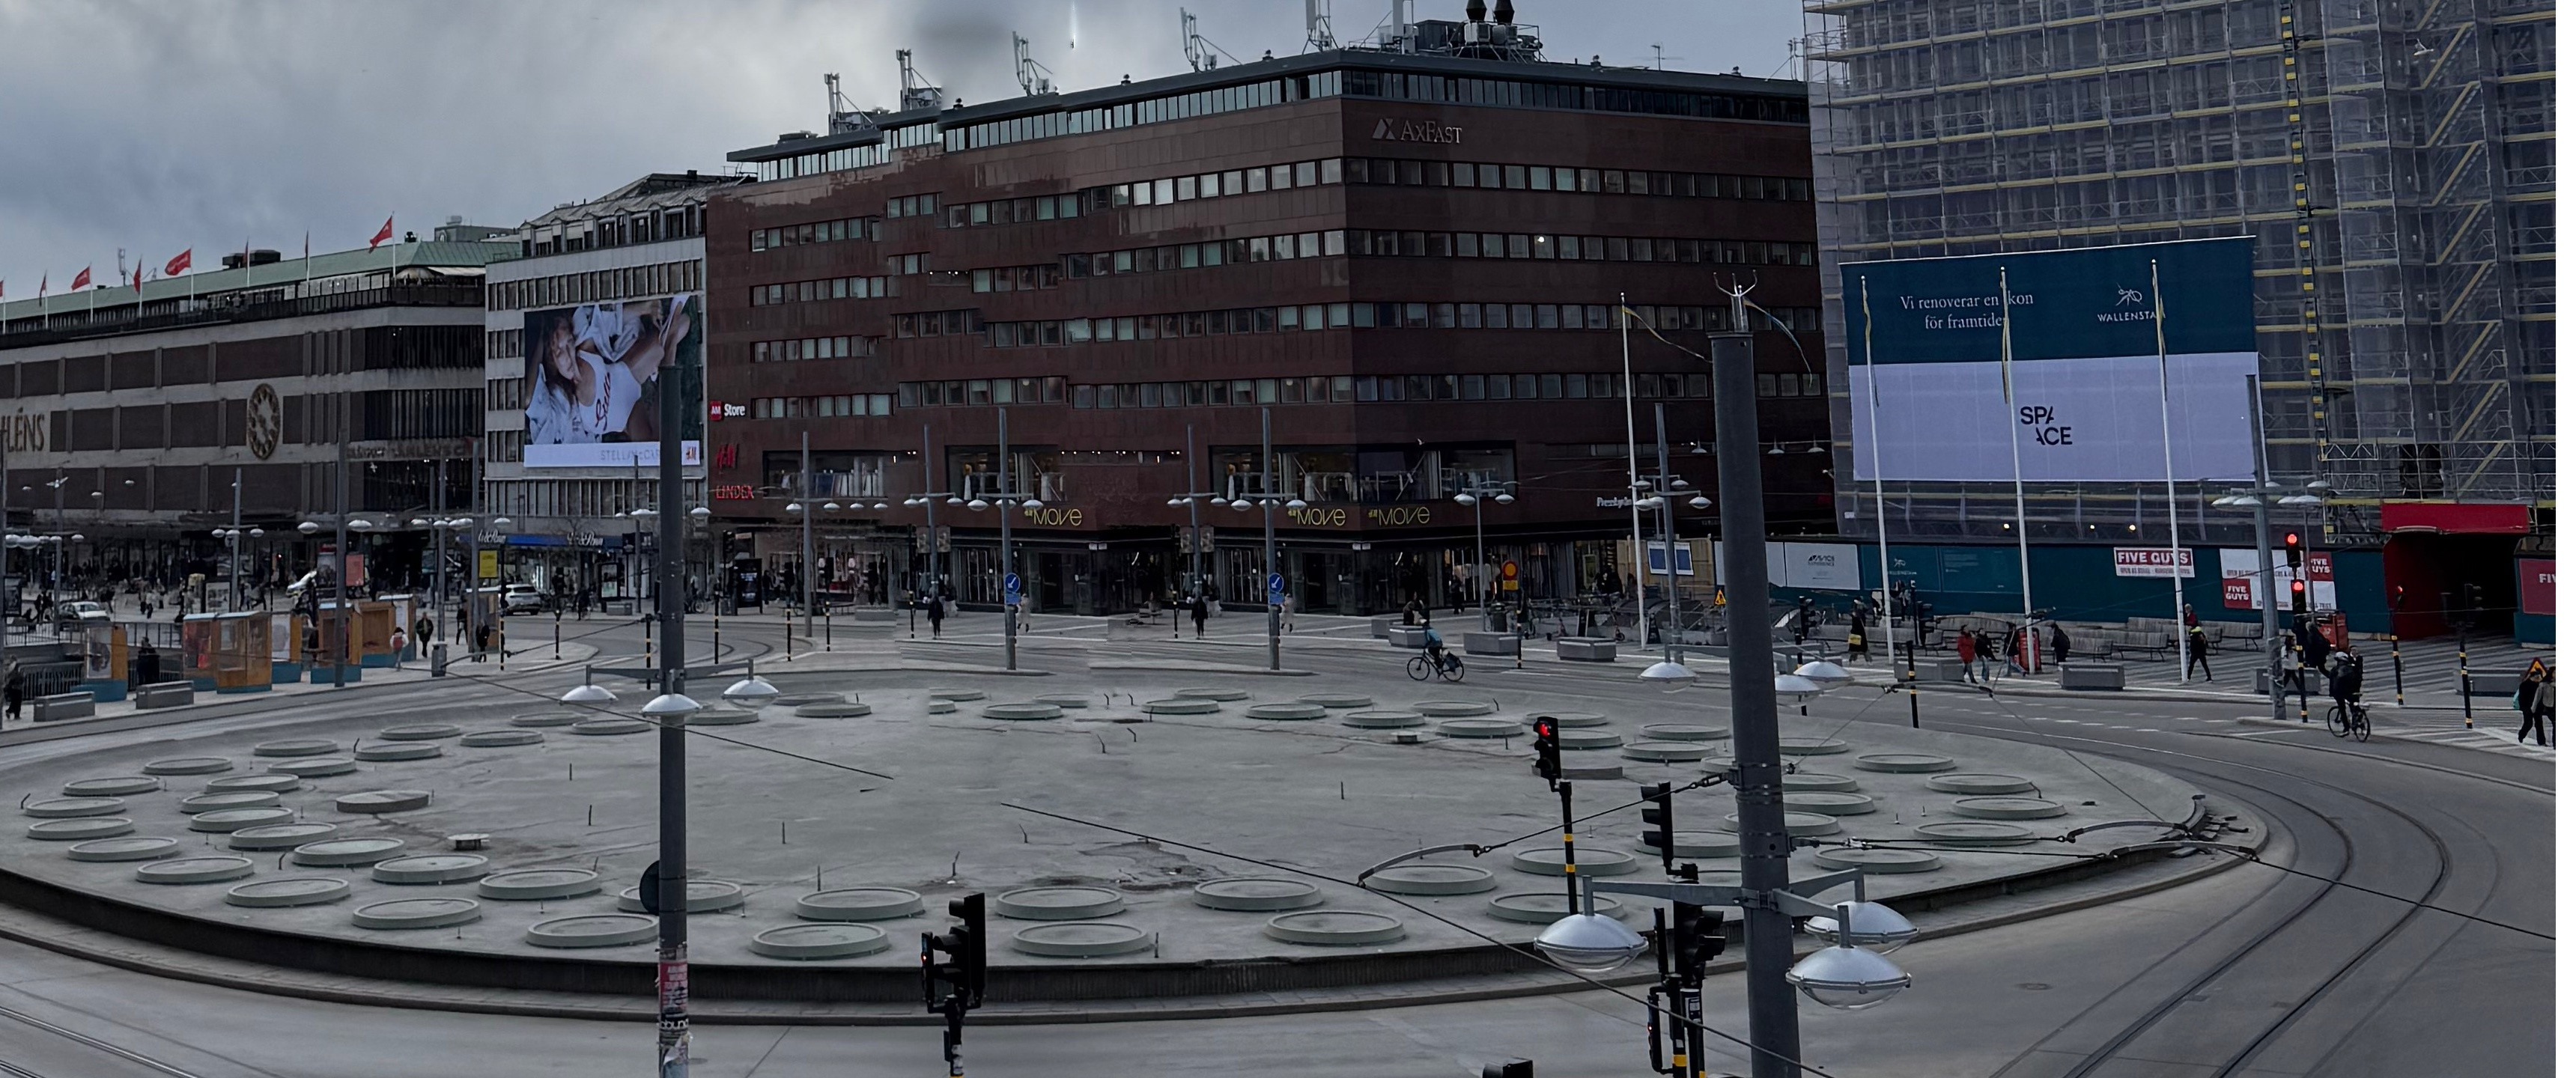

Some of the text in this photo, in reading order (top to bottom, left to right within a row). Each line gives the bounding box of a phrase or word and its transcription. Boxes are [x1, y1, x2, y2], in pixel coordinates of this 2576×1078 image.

[1900, 290, 2034, 310] Vi renoverar en kon
[1925, 311, 2005, 330] för framtide
[2097, 311, 2157, 323] WALLENSTA
[723, 404, 746, 416] Store
[716, 484, 754, 499] LINDEX
[2117, 552, 2148, 563] FIVE
[2312, 565, 2330, 573] UYS
[2227, 585, 2247, 593] FIVE
